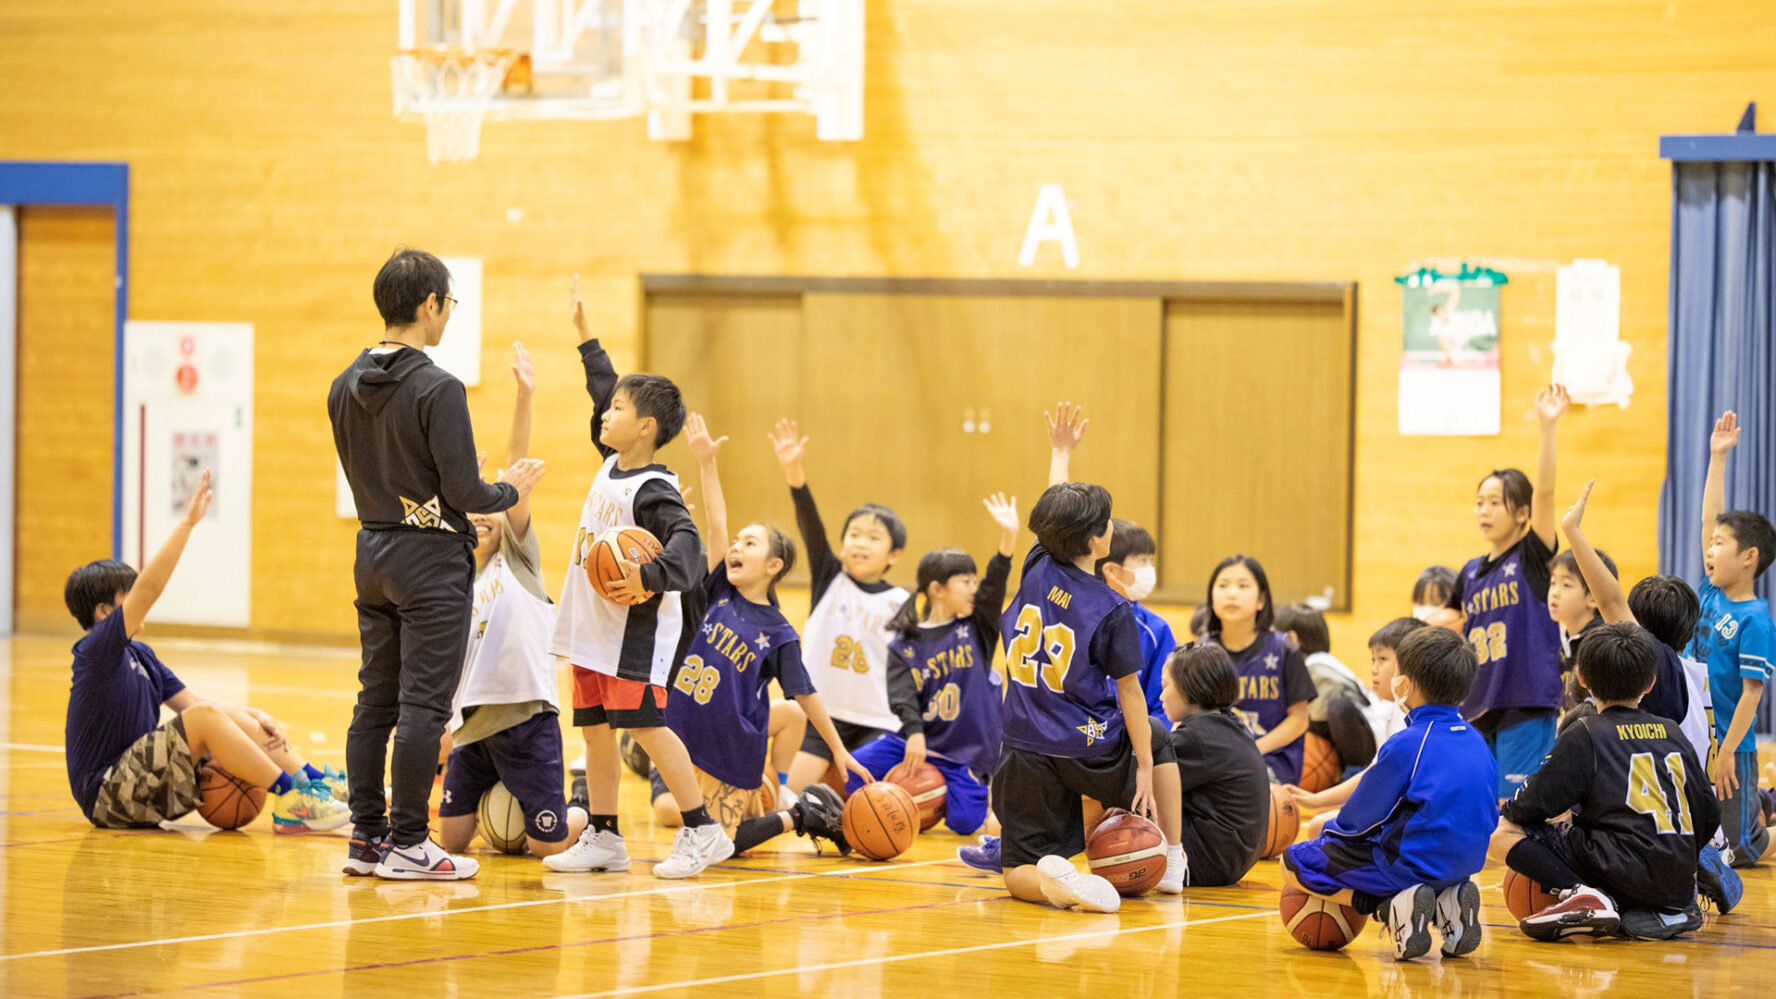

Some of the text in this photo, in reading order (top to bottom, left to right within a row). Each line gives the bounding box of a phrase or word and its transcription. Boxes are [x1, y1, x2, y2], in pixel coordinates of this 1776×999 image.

[1018, 184, 1080, 269] A
[1046, 585, 1073, 611] MAI
[1472, 580, 1519, 616] STARS
[1468, 621, 1508, 666] 32
[1714, 612, 1739, 640] 13
[706, 622, 756, 673] STARS
[830, 634, 870, 675] 26
[928, 643, 974, 680] STARS
[1007, 603, 1076, 694] 29
[673, 653, 721, 706] 28
[1238, 675, 1280, 700] TARS
[1616, 723, 1668, 741] KYOICHI
[1625, 752, 1695, 835] 41
